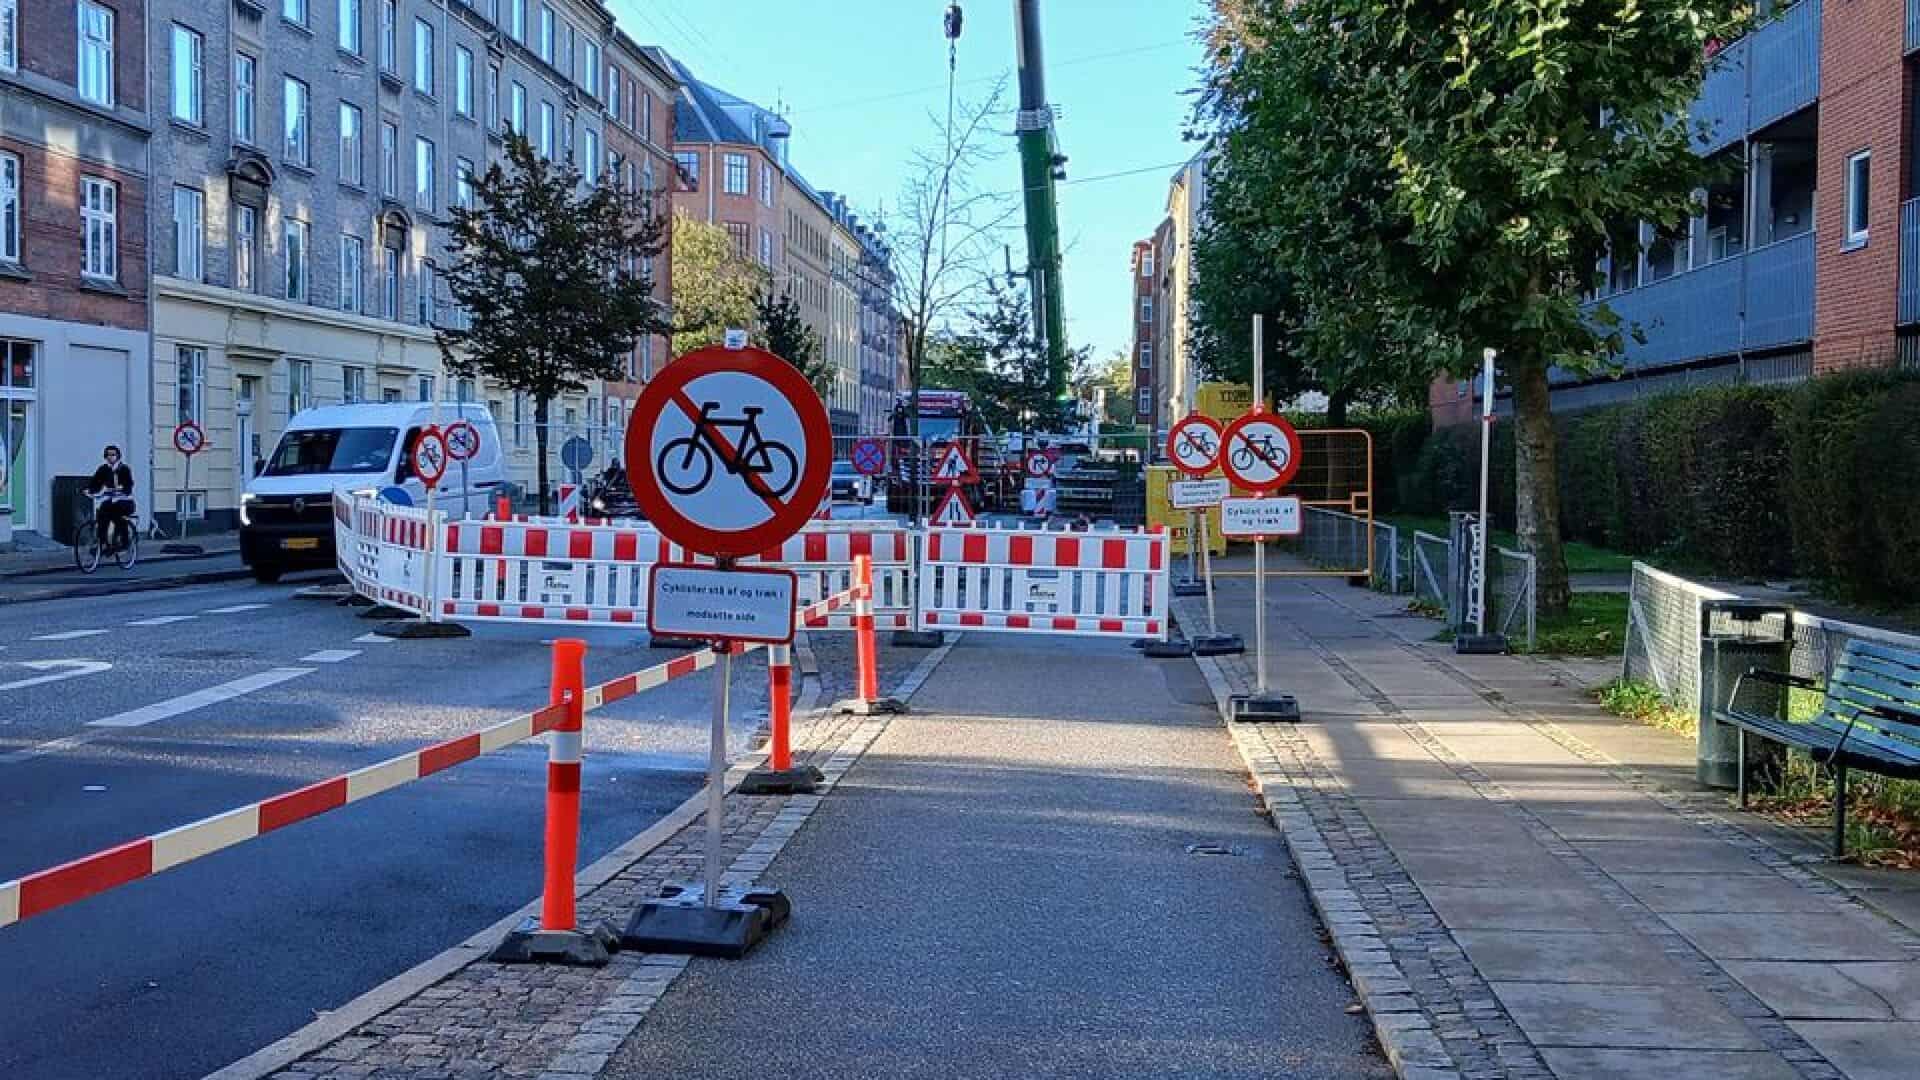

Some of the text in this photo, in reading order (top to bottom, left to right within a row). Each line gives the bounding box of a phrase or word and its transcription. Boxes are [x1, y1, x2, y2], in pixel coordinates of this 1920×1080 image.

[1284, 506, 1294, 514] af
[1242, 519, 1253, 527] og
[661, 583, 705, 595] Cyklister
[707, 584, 725, 596] stå
[727, 586, 737, 596] af
[740, 589, 753, 598] og
[755, 588, 777, 598] træk
[687, 608, 756, 622] modsatte side
